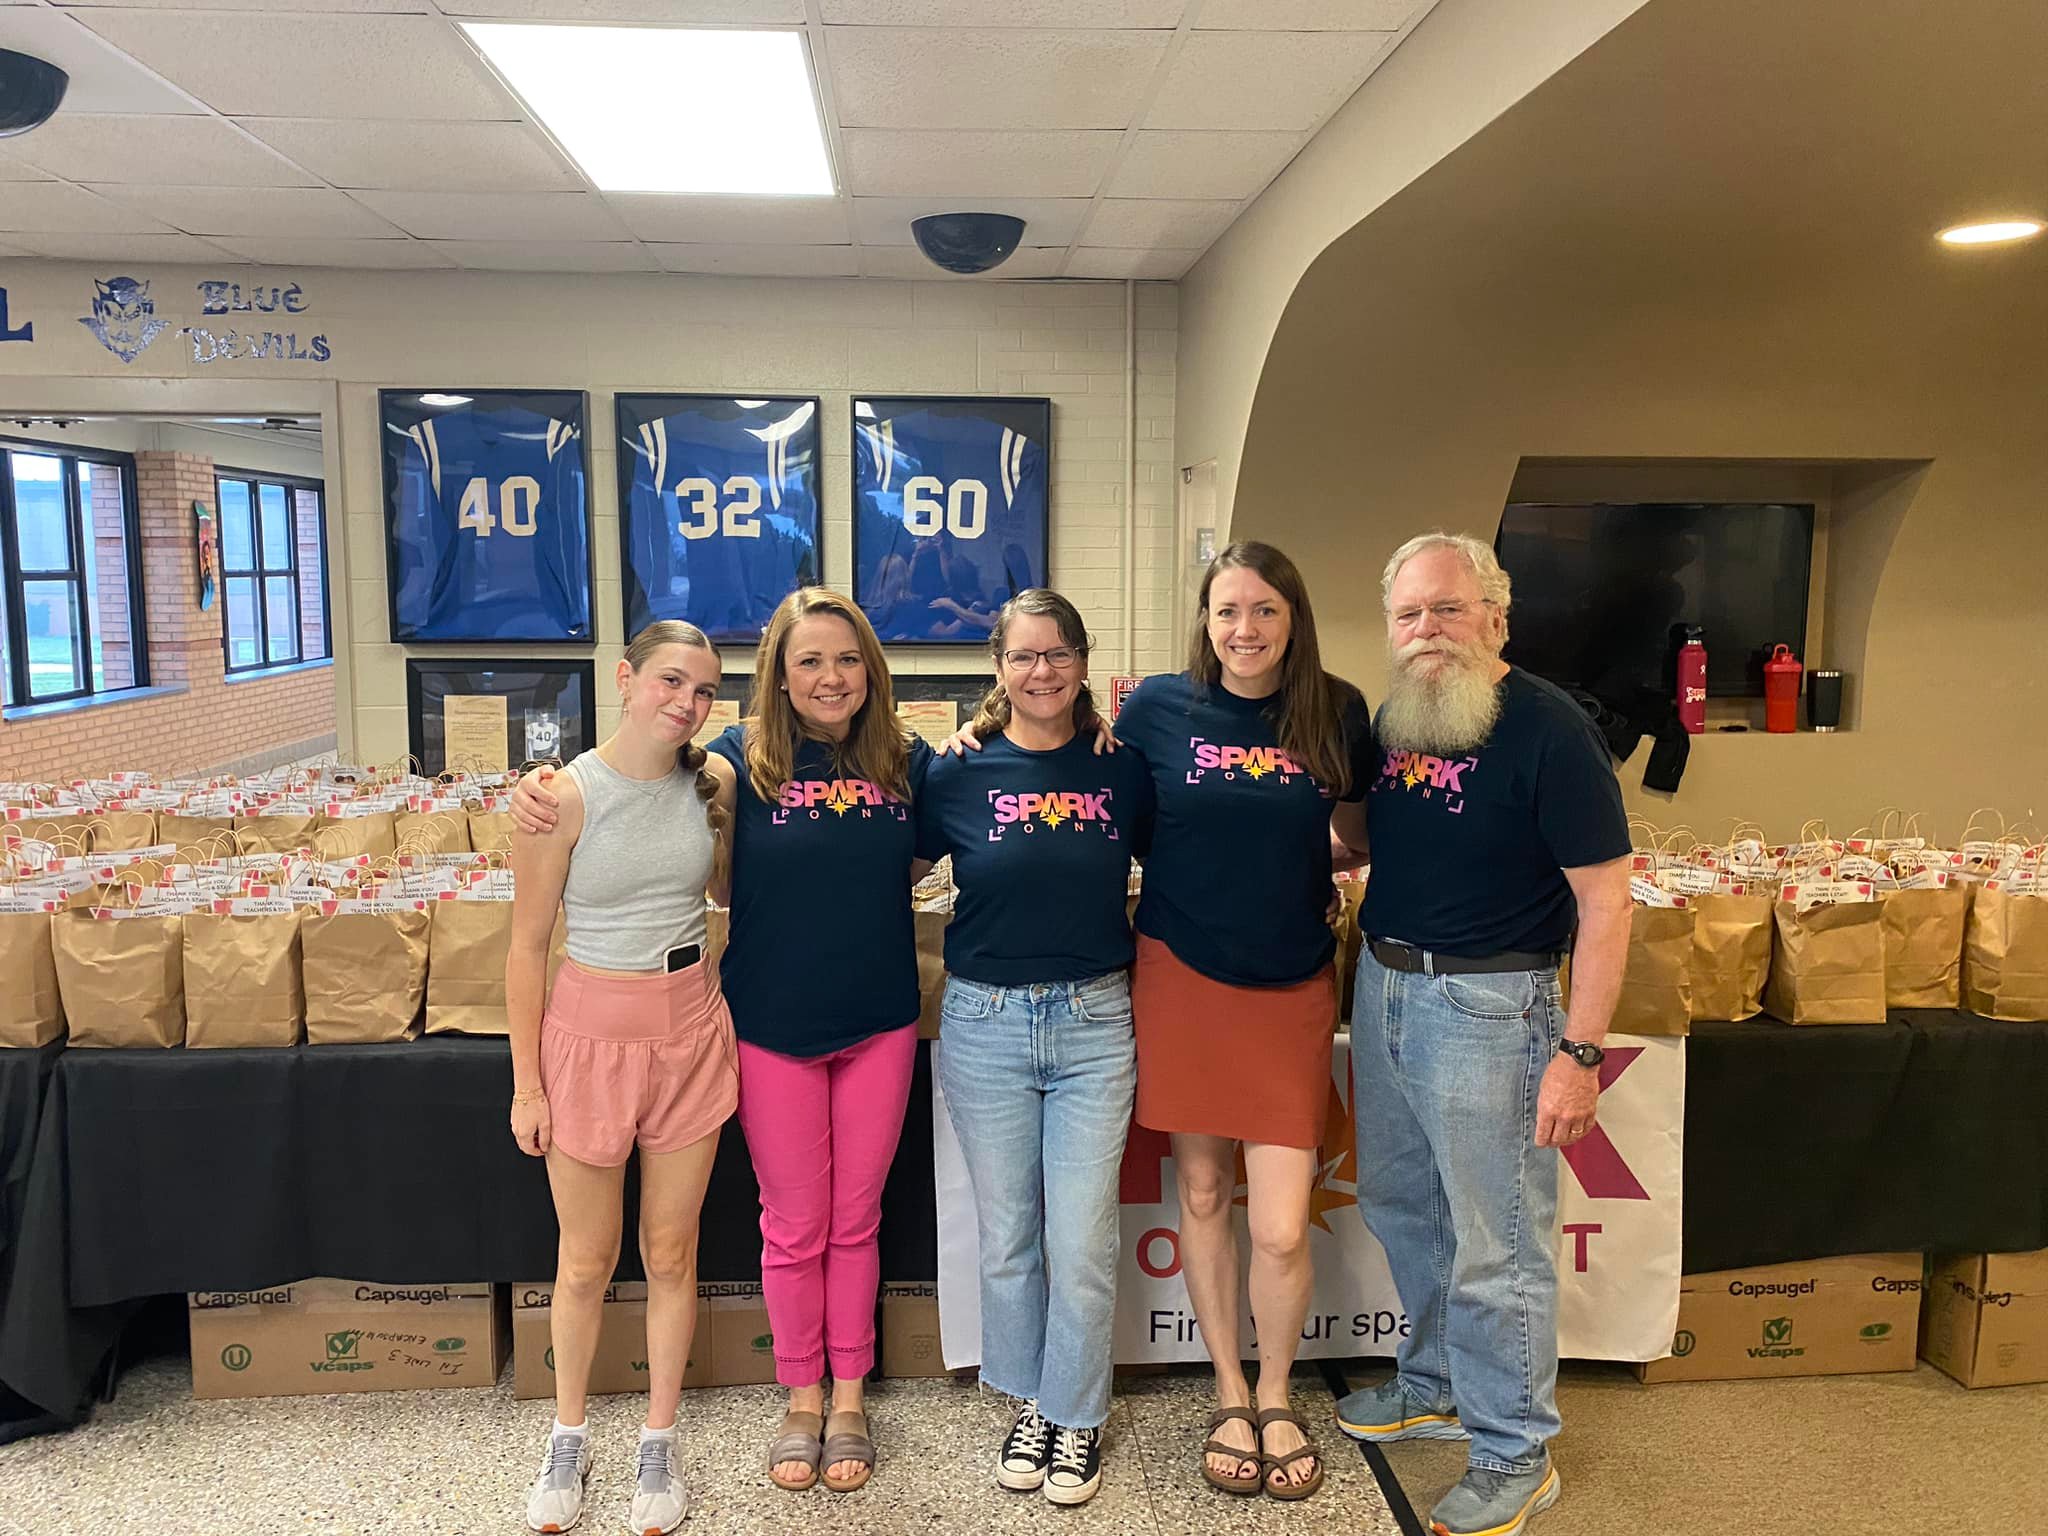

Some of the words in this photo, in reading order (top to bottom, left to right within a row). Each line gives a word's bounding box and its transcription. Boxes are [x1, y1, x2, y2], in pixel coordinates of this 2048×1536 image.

[458, 477, 541, 537] 40
[675, 476, 761, 539] 32
[903, 476, 988, 539] 60
[536, 731, 551, 742] 40
[1194, 744, 1304, 774] SPAR
[994, 792, 1112, 824] SPARK
[354, 1286, 450, 1305] Capsugel
[697, 1281, 762, 1300] apsuge
[1728, 1278, 1816, 1298] Capsugel
[1871, 1276, 1921, 1295] Caps
[194, 1287, 292, 1305] Capsugel
[1352, 1311, 1412, 1344] spa
[388, 1349, 401, 1361] 3
